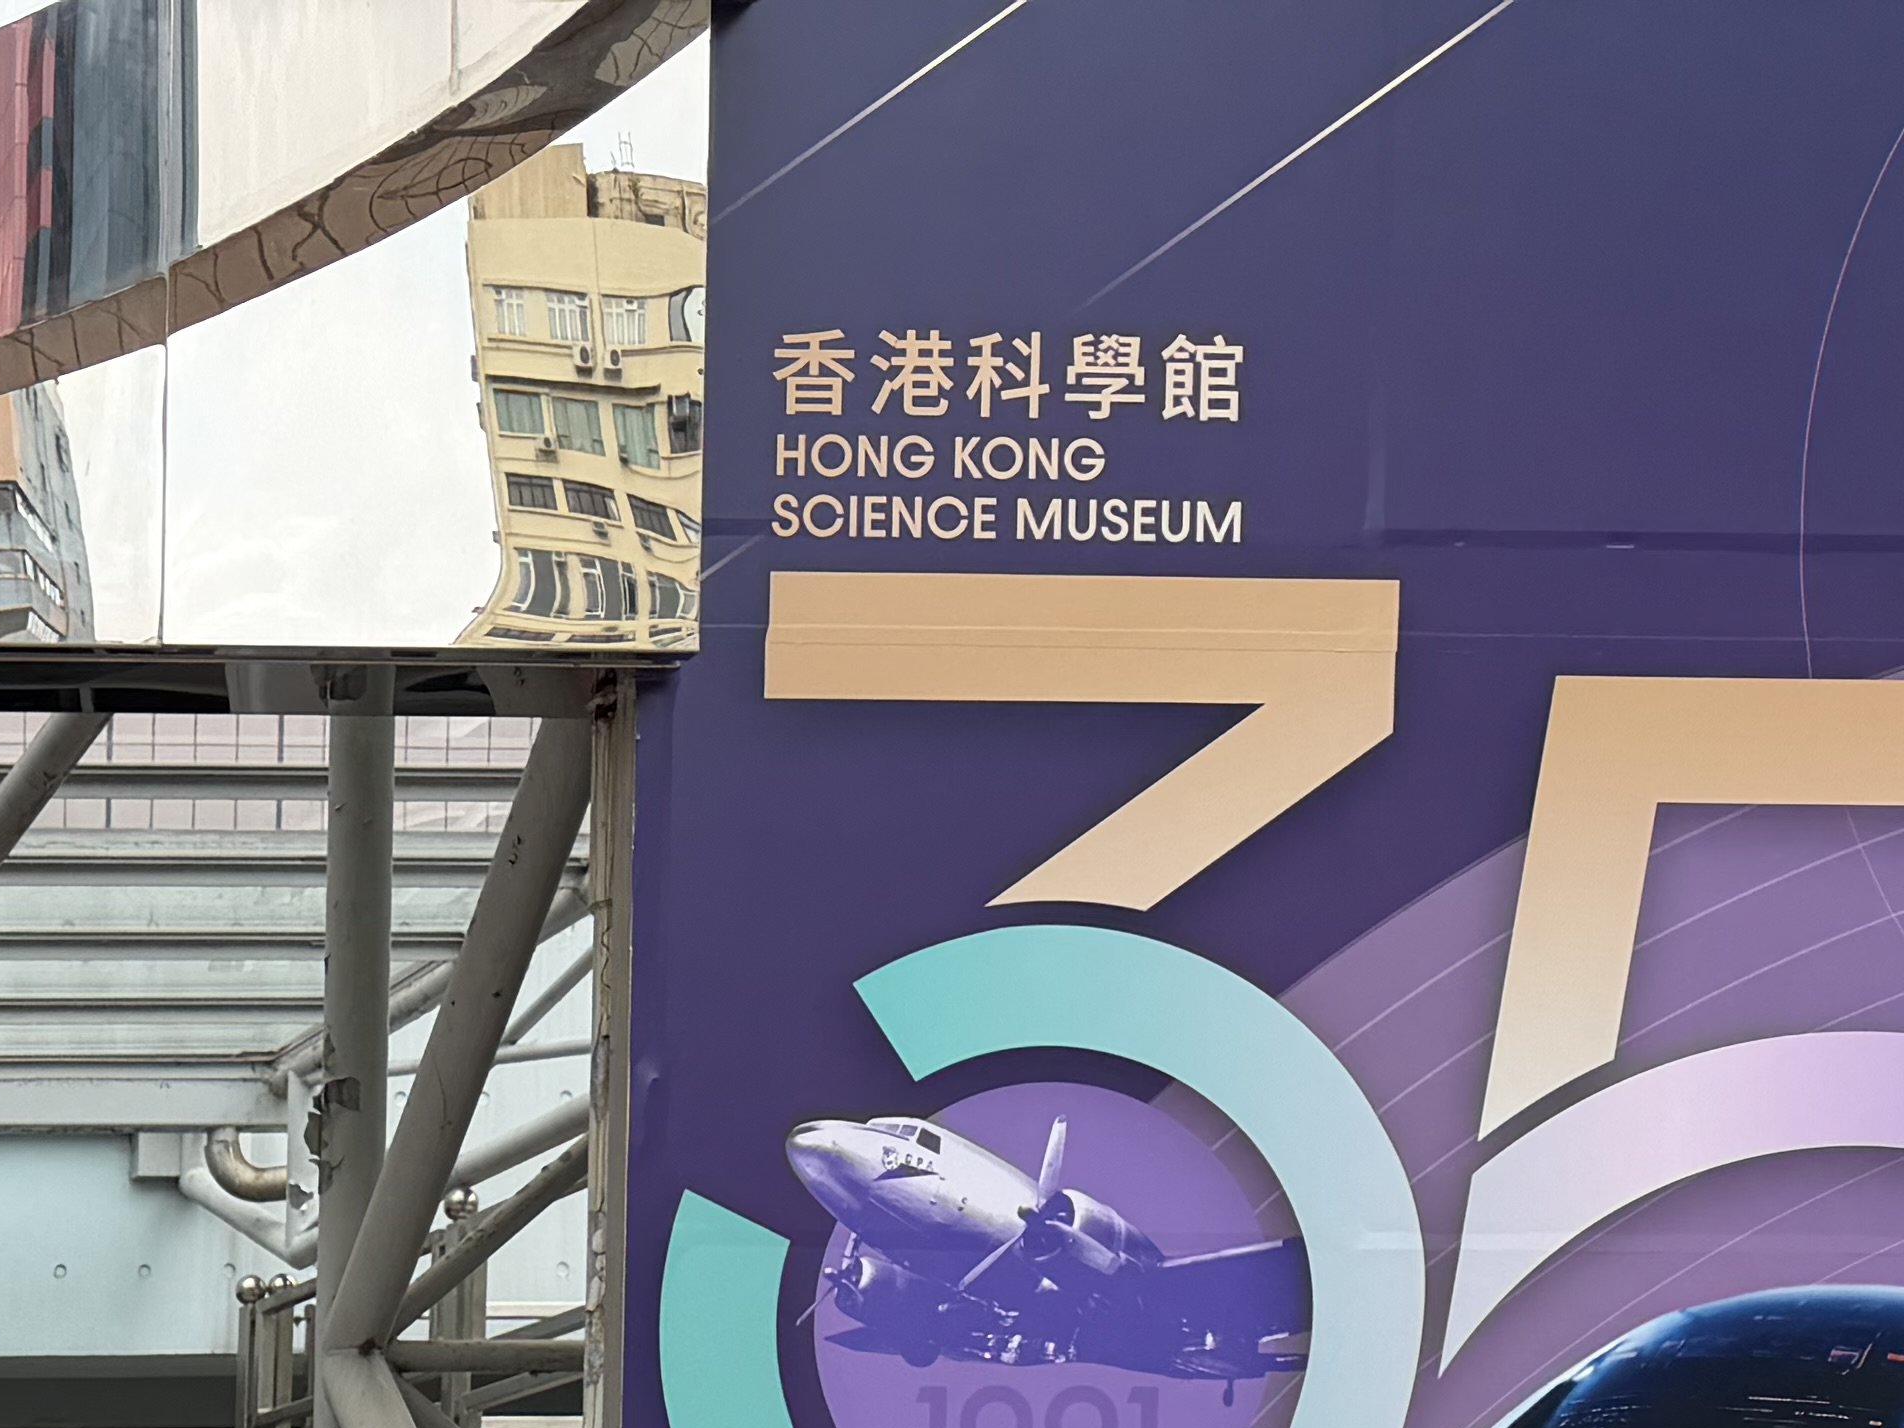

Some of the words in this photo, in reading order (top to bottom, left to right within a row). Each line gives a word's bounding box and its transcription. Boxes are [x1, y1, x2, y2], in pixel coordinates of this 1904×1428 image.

[772, 328, 1244, 423] 香港科學館
[775, 433, 935, 480] HONG
[953, 435, 1106, 481] KONG
[771, 493, 998, 540] SCIENCE
[1016, 497, 1242, 544] MUSEUM
